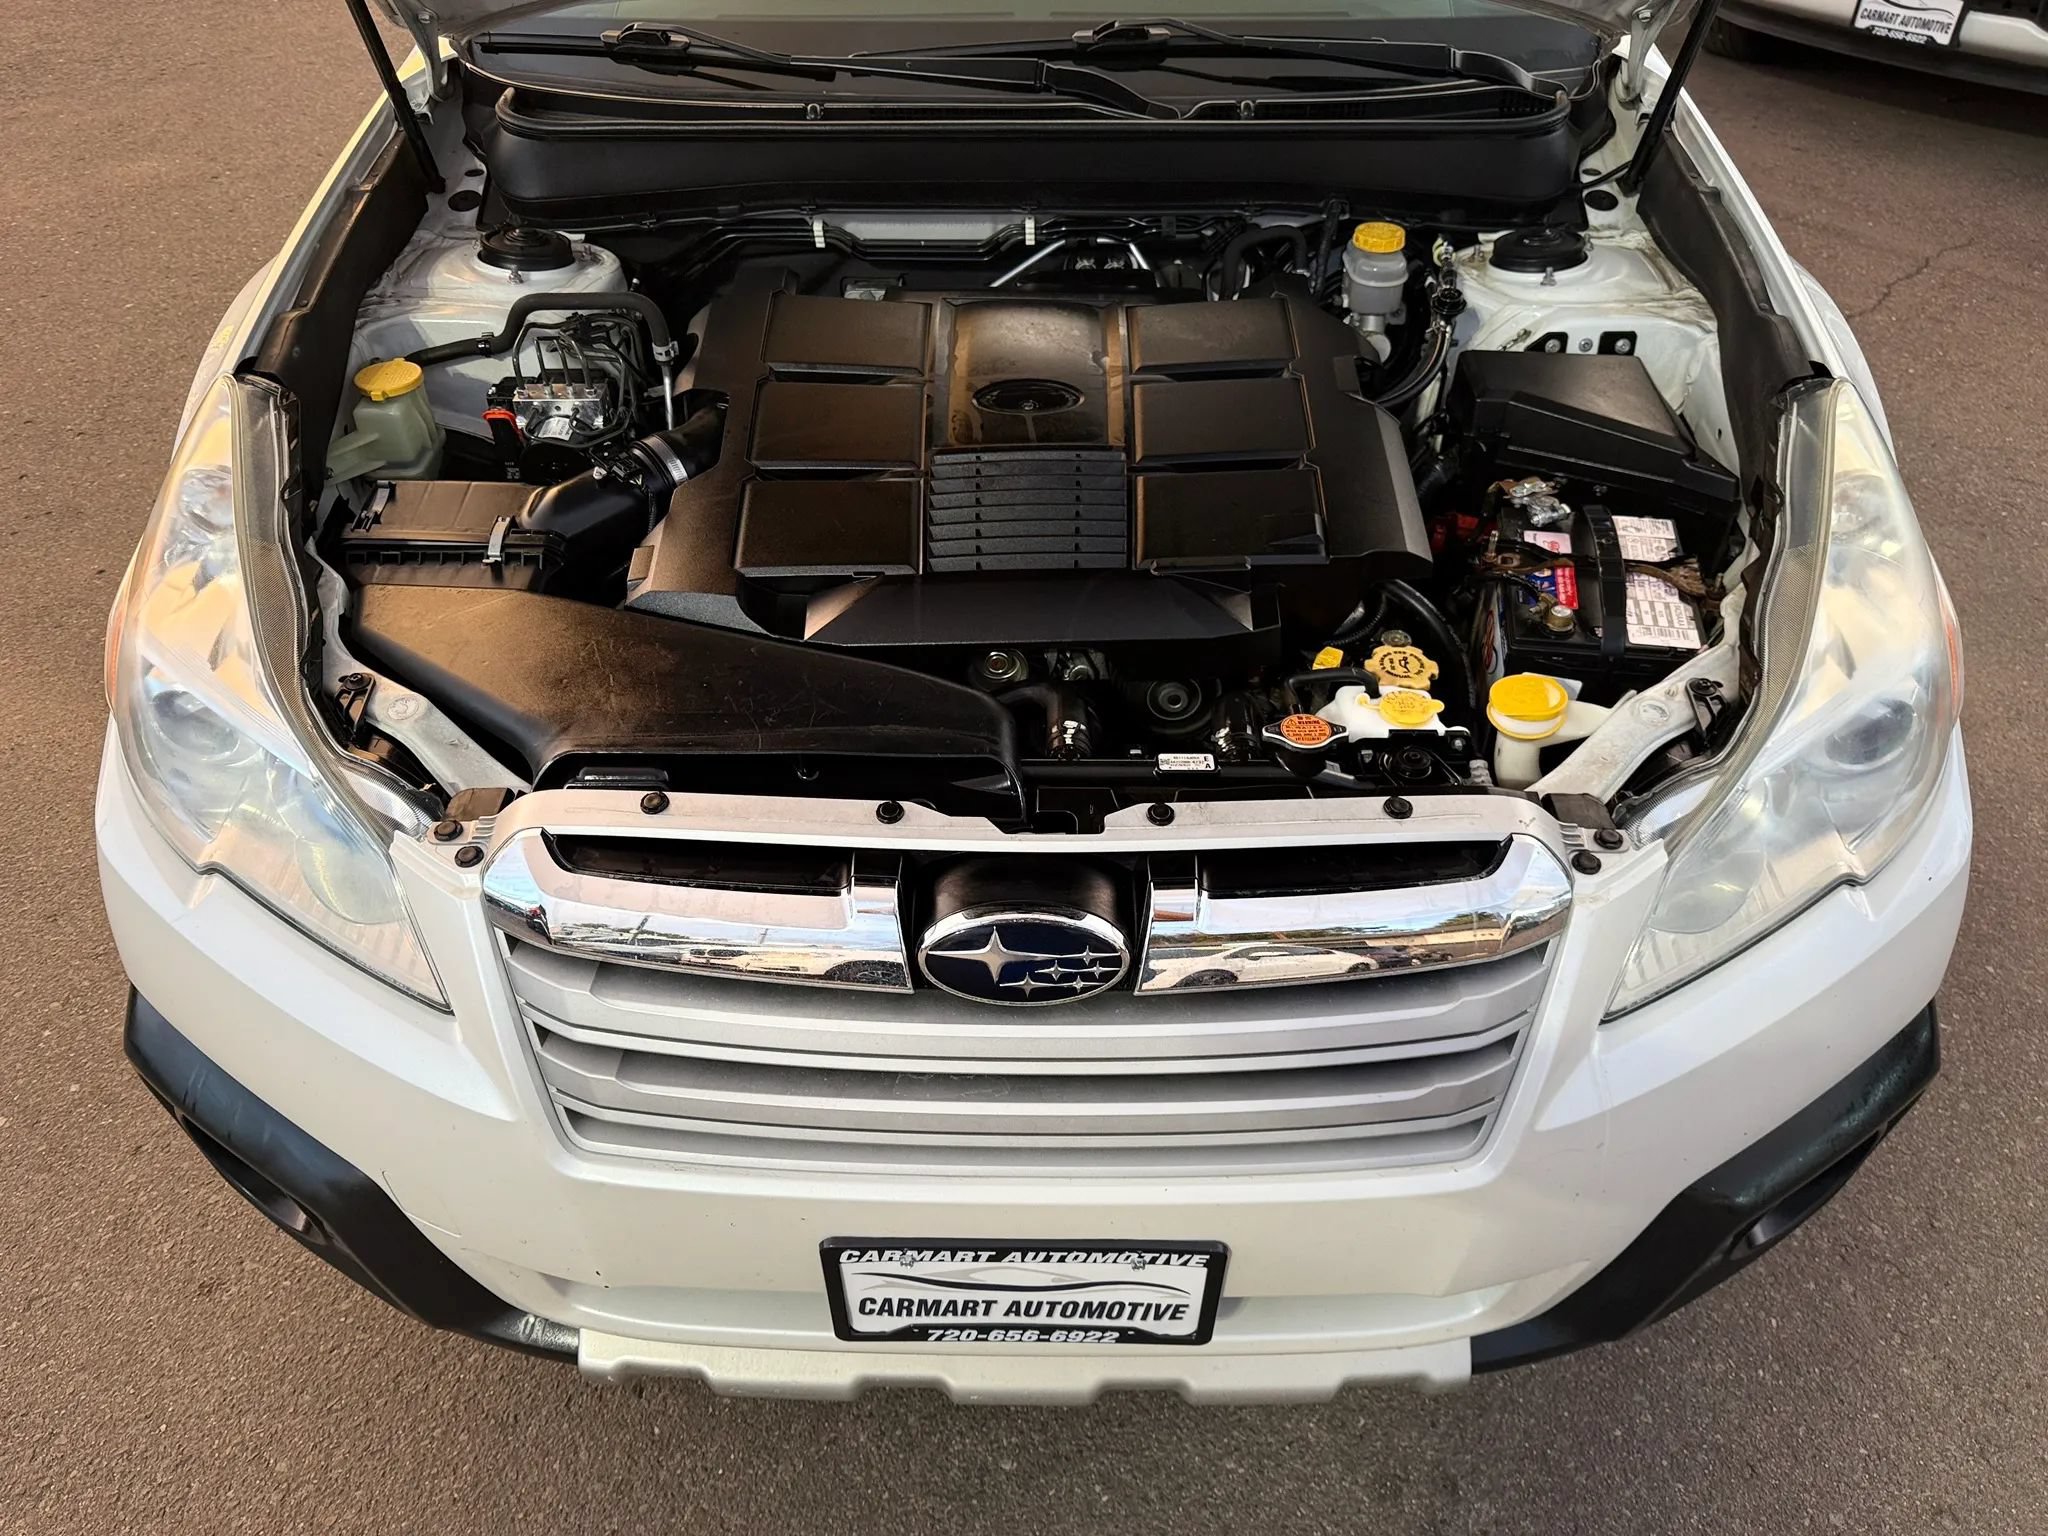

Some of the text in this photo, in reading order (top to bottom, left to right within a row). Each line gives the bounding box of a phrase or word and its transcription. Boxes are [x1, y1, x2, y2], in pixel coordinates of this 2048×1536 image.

[1860, 7, 1953, 35] CARMART AUTOMOTIVE
[839, 1249, 1211, 1268] CARMART AUTOMOTIVE
[858, 1297, 1190, 1322] CARMART AUTOMOTIVE
[927, 1328, 1120, 1344] 720-656-6922
